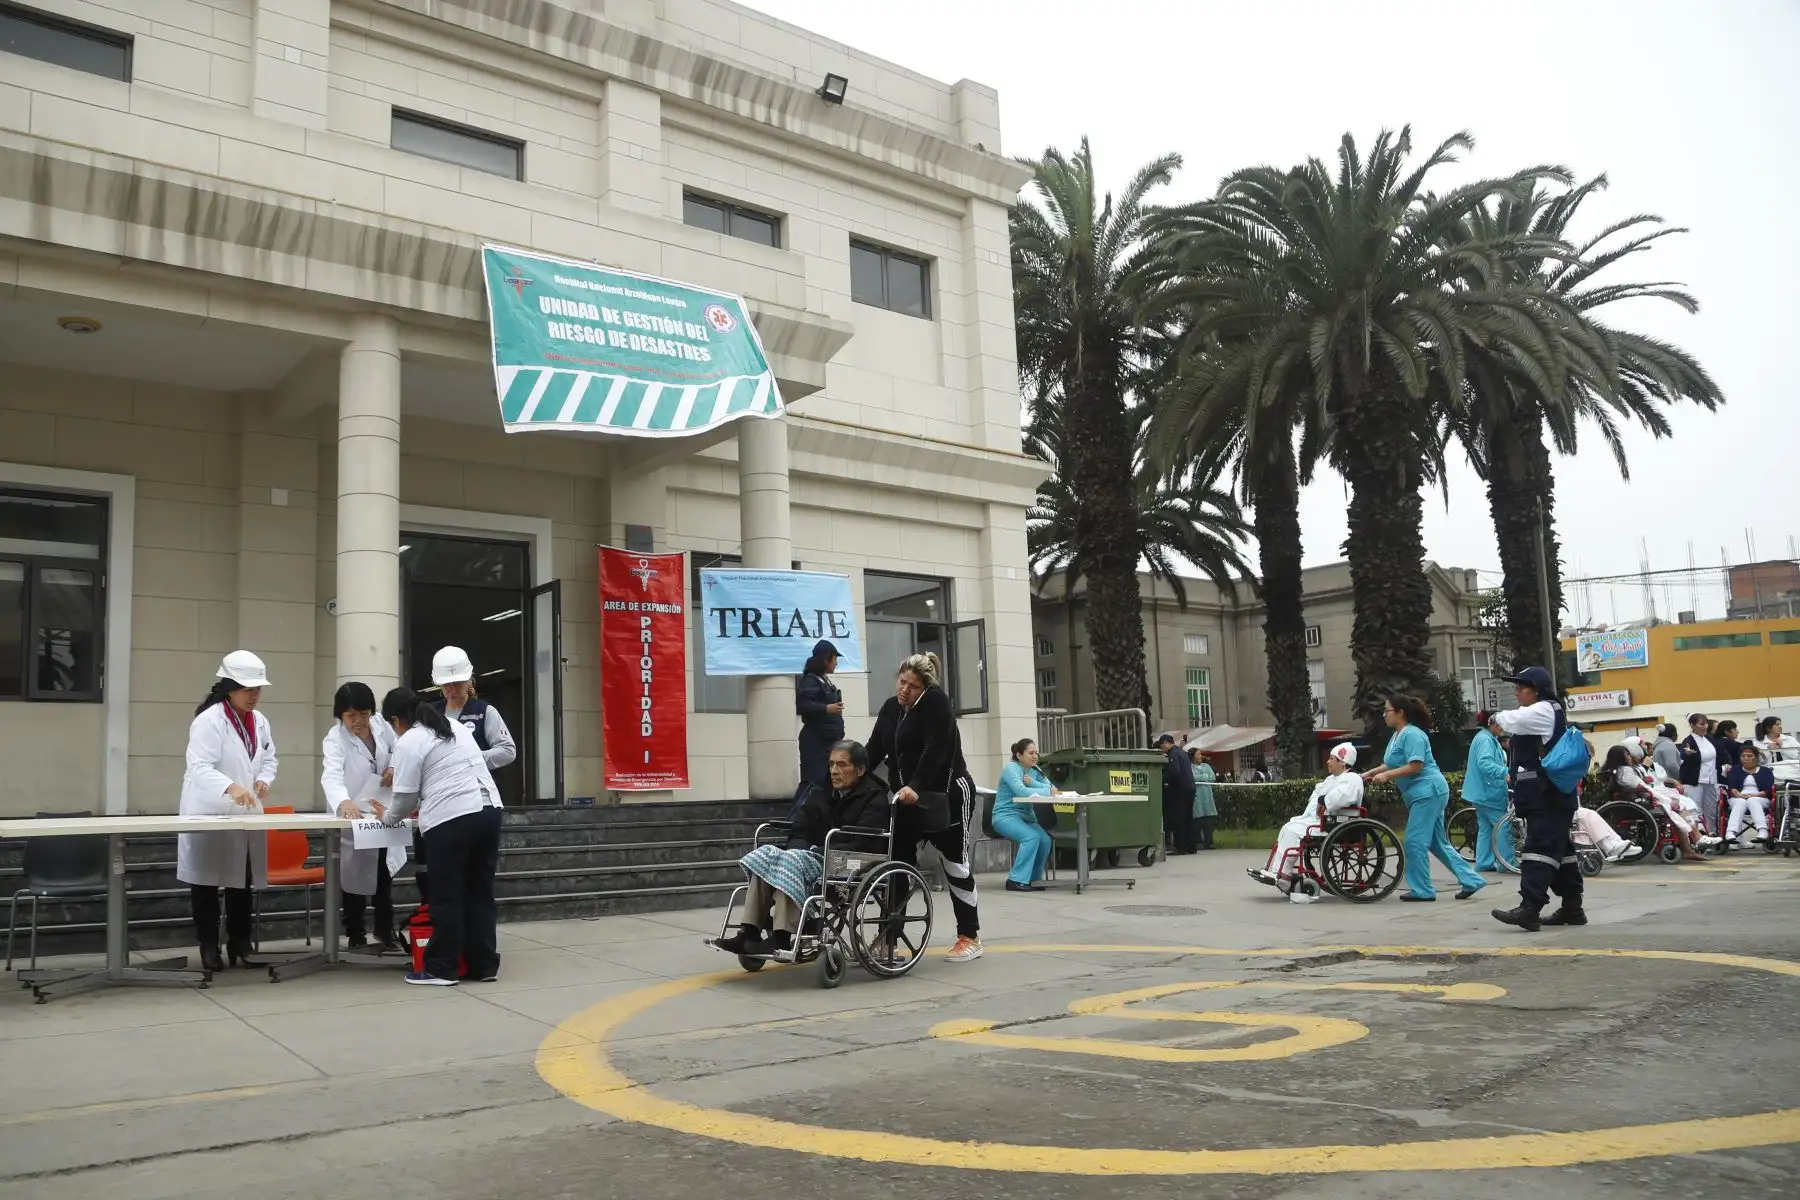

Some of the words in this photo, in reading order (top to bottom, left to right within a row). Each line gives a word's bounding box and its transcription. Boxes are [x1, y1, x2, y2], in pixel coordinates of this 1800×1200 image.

[539, 295, 600, 321] UNIDAD
[601, 306, 622, 325] DE
[623, 311, 685, 336] GESTIÓN
[685, 322, 711, 342] DEL
[548, 321, 606, 346] RIESGO
[608, 330, 629, 349] DE
[629, 333, 712, 362] DESASTRES
[604, 600, 626, 611] AREA
[628, 602, 640, 611] DE
[641, 602, 681, 614] EXPANSIÓN
[710, 607, 850, 639] TRIAJE
[640, 616, 653, 737] PRIORIDAD
